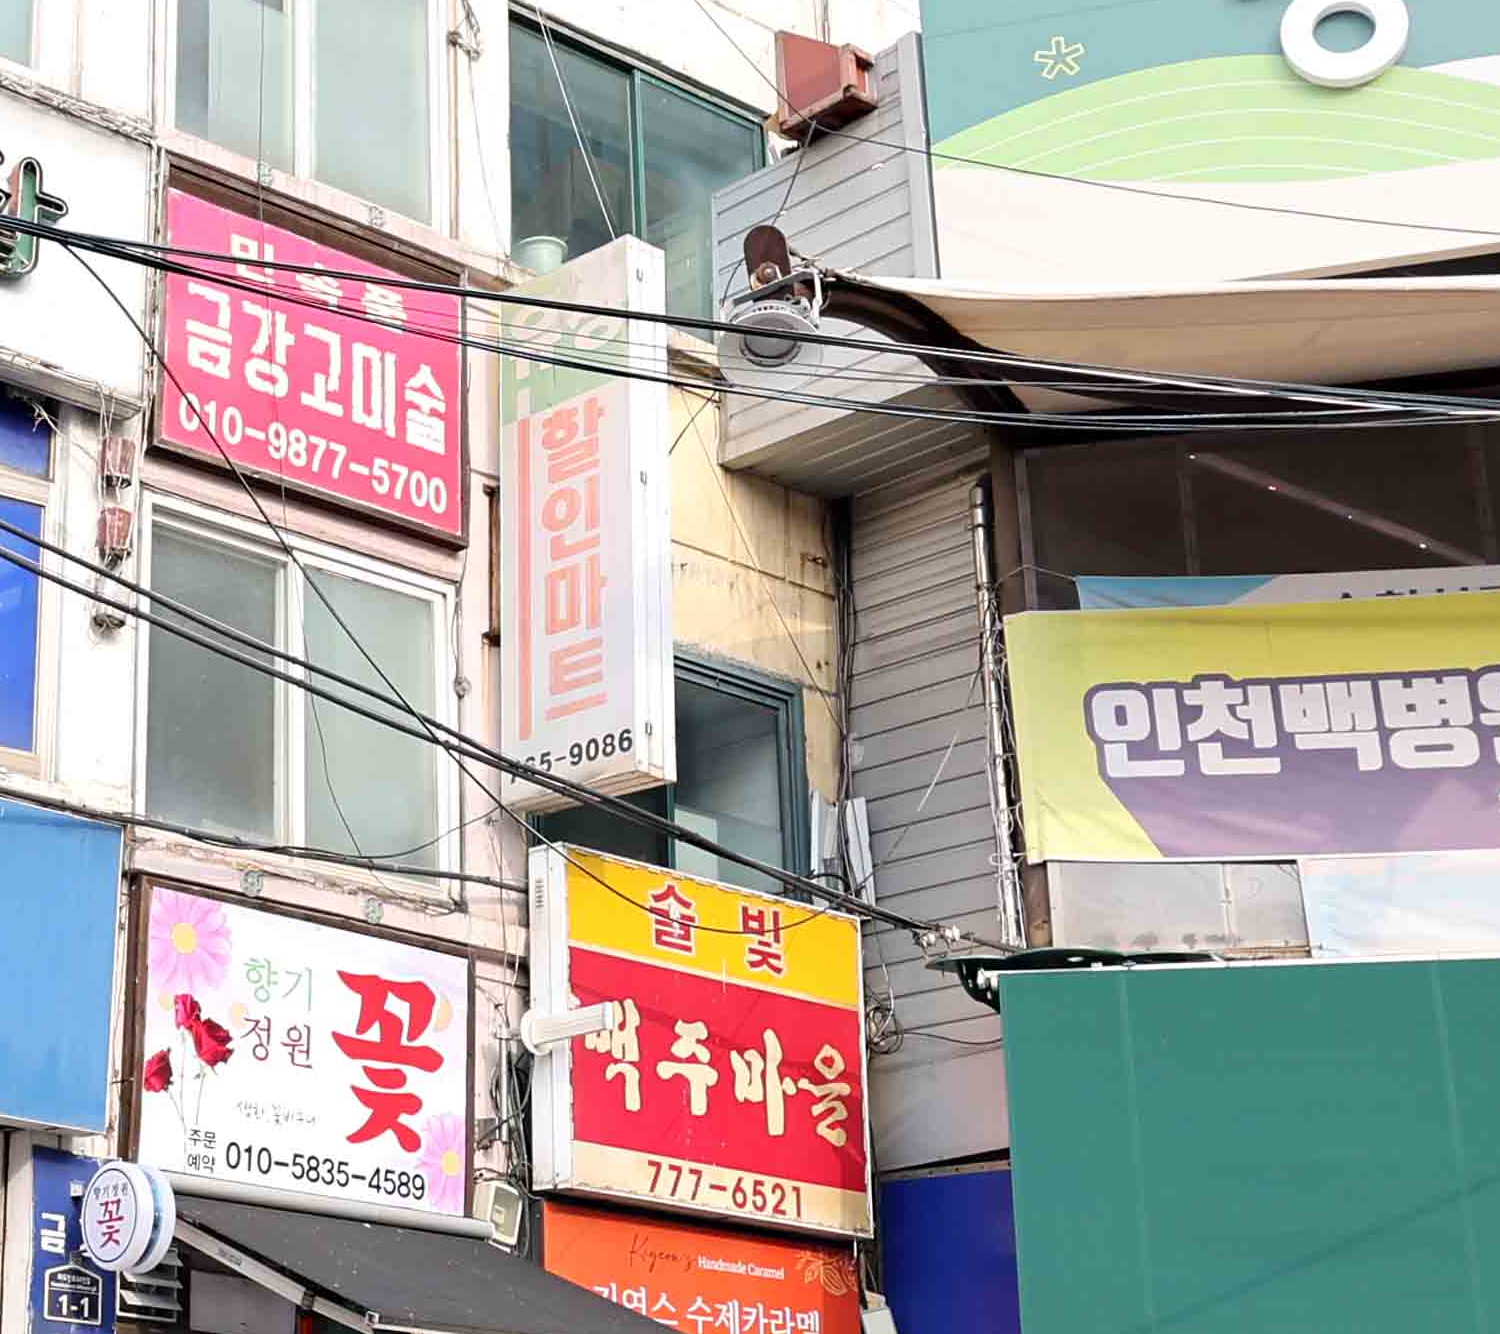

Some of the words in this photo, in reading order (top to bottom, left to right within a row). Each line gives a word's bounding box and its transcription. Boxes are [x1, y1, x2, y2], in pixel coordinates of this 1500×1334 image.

[184, 280, 447, 457] 금강고미술
[178, 392, 449, 516] 010-9877-5700
[540, 394, 608, 725] 할인마트
[510, 728, 634, 784] 5-9086
[650, 882, 785, 976] 솔빛
[243, 956, 313, 1013] 향기
[240, 1015, 313, 1069] 정원
[330, 969, 445, 1154] 꽃
[187, 1127, 216, 1149] 주문
[225, 1141, 426, 1201] 010-5835-4589
[647, 1159, 803, 1220] 777-6521
[96, 1198, 125, 1249] 꽃
[748, 1262, 785, 1281] Caramel
[56, 1294, 90, 1317] 1-1
